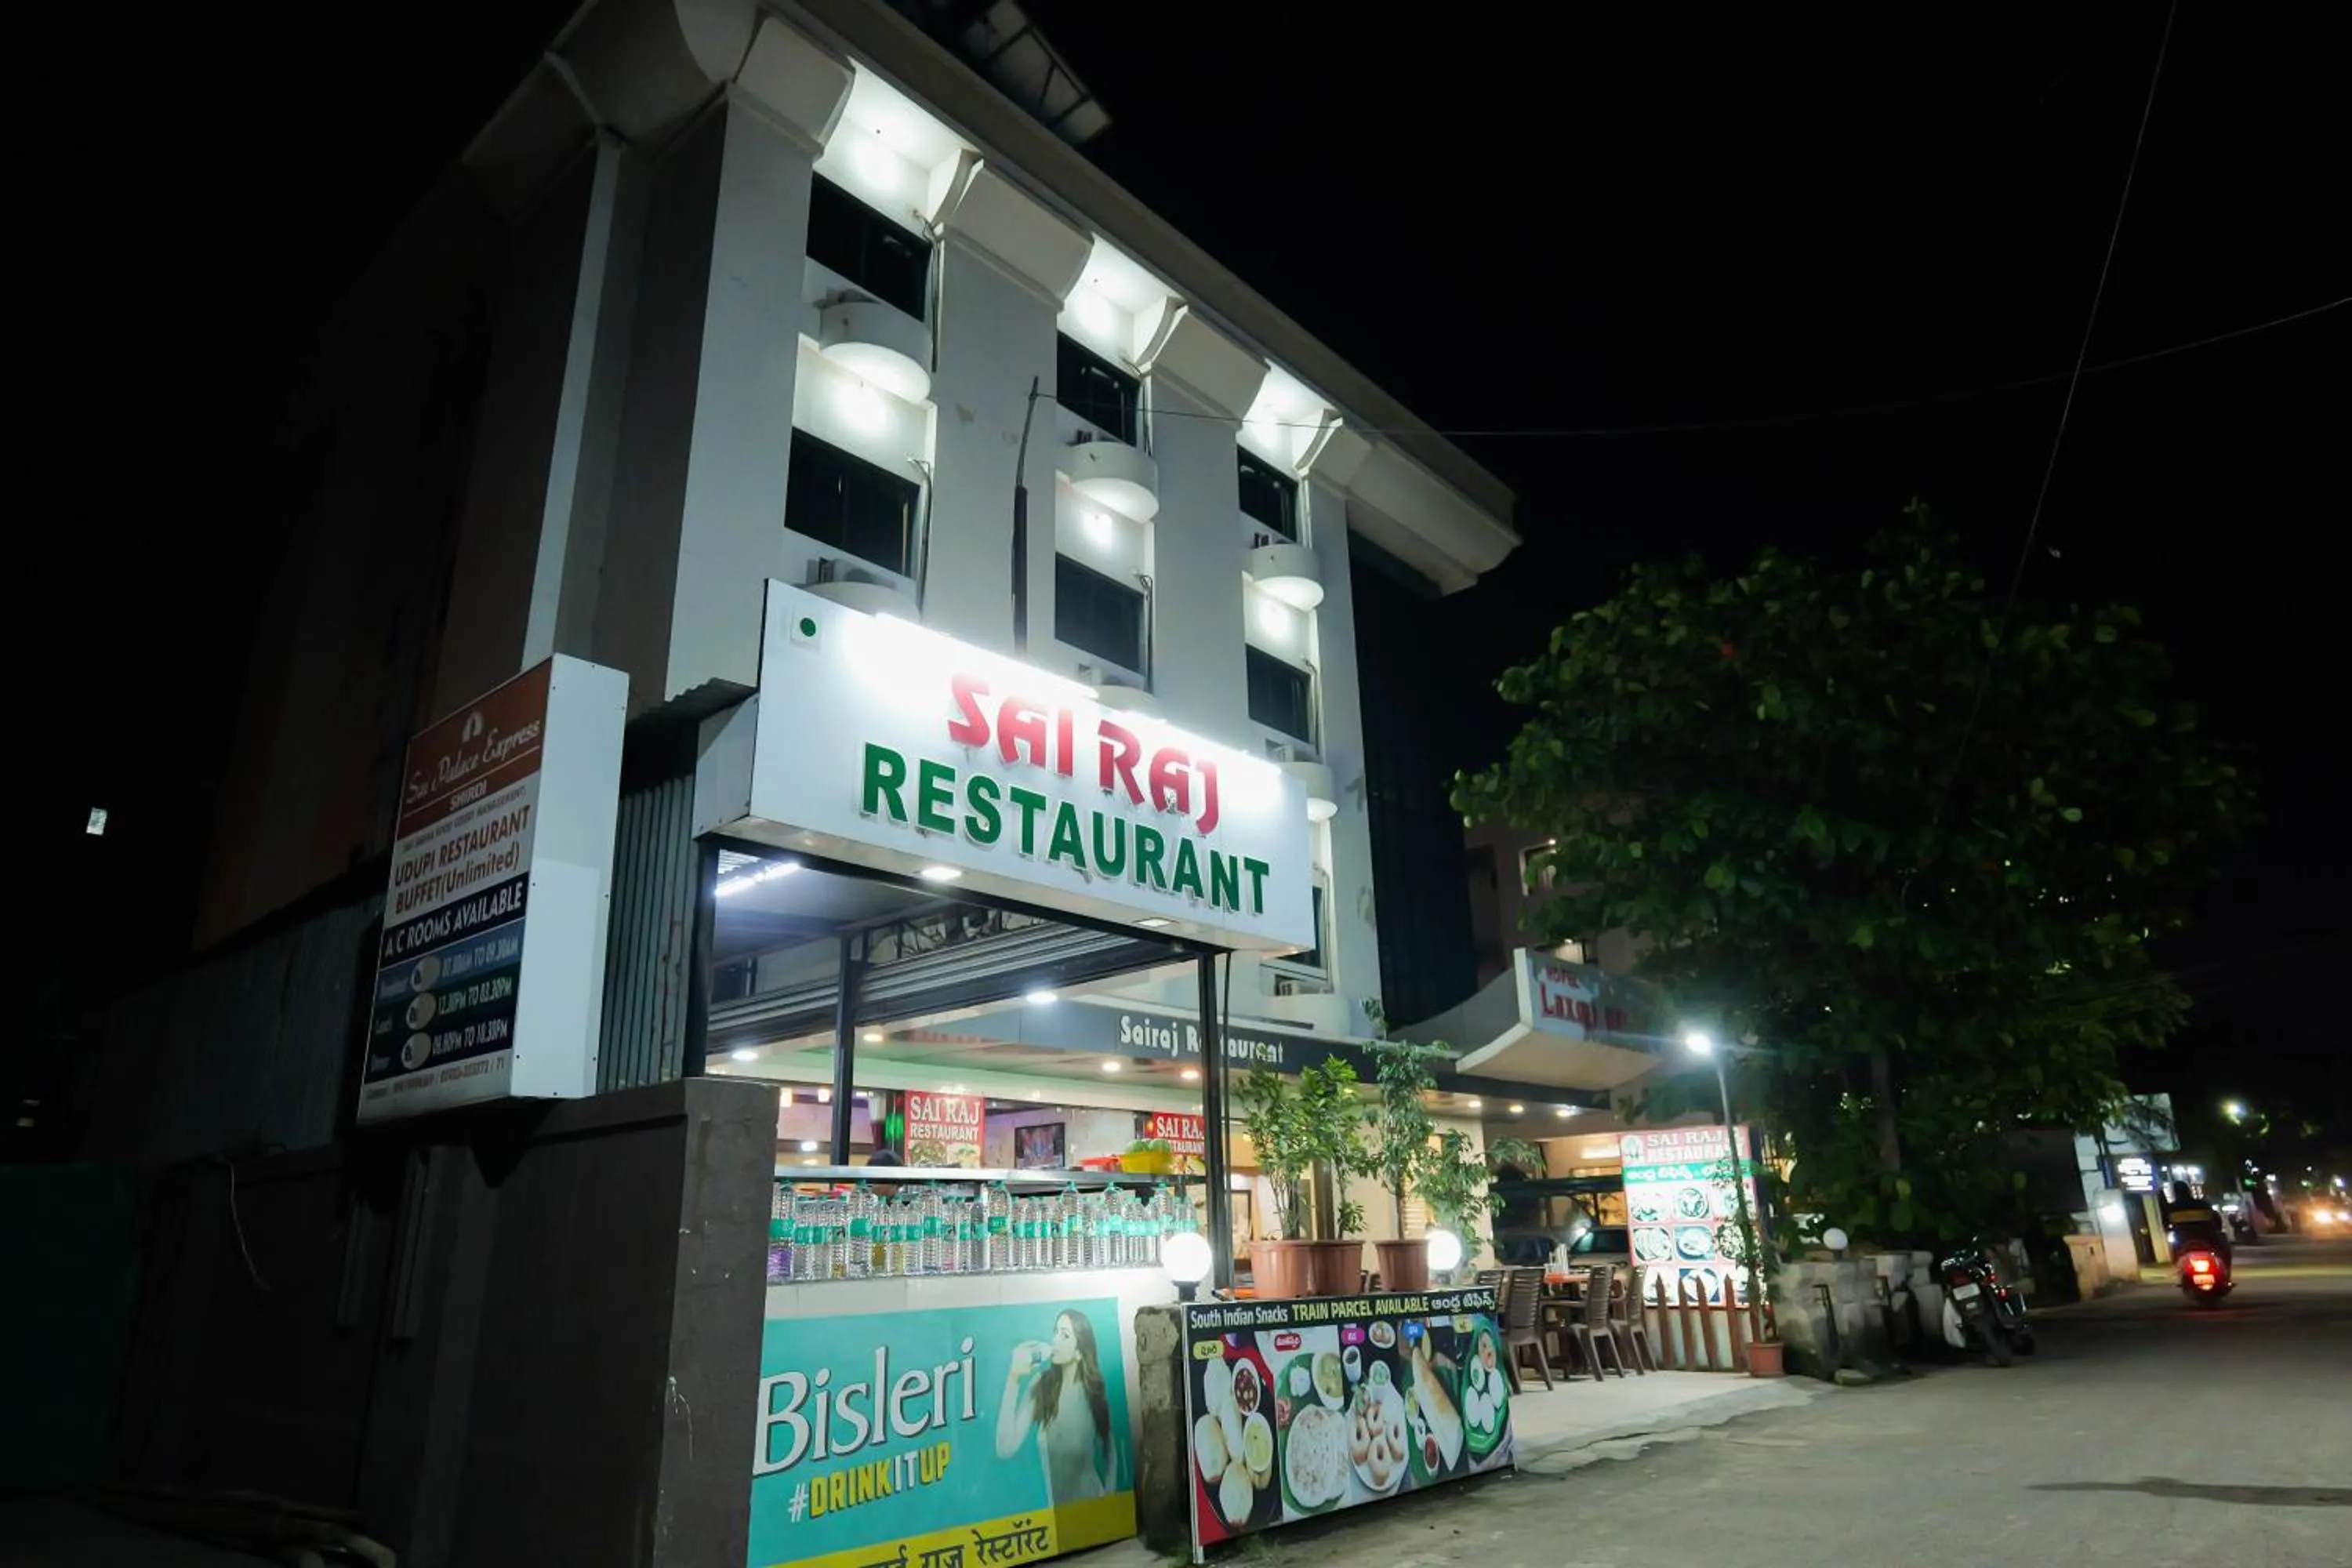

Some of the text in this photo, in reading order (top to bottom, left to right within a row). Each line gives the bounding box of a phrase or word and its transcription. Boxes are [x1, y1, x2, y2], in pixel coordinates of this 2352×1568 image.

[483, 720, 540, 762] Express
[947, 673, 1220, 837] SAI RAJ
[394, 805, 531, 887] UDUPI RESTAURANT
[861, 741, 1270, 916] RESTAURANT
[396, 840, 520, 913] BUFFET(Unlimited)
[406, 909, 452, 949] ROOMS
[452, 880, 523, 932] AVAILABLE
[468, 985, 479, 1006] TO
[464, 1025, 475, 1047] TO
[1120, 1014, 1283, 1063] Sairaj Rtaurant
[910, 1096, 980, 1125] SAI RAJ
[910, 1123, 978, 1142] RESTAURANT
[1156, 1116, 1179, 1138] SAI
[1647, 1130, 1722, 1147] SAI RAJ
[1191, 1308, 1221, 1329] South
[1223, 1307, 1254, 1327] Indian
[1255, 1305, 1288, 1324] Snacks
[1291, 1302, 1329, 1321] TRAIN
[1331, 1299, 1374, 1319] PARCEL
[1375, 1296, 1429, 1316] AVAILABLE
[753, 1336, 977, 1477] Bisleri
[788, 1442, 951, 1523] #DRINKITUP
